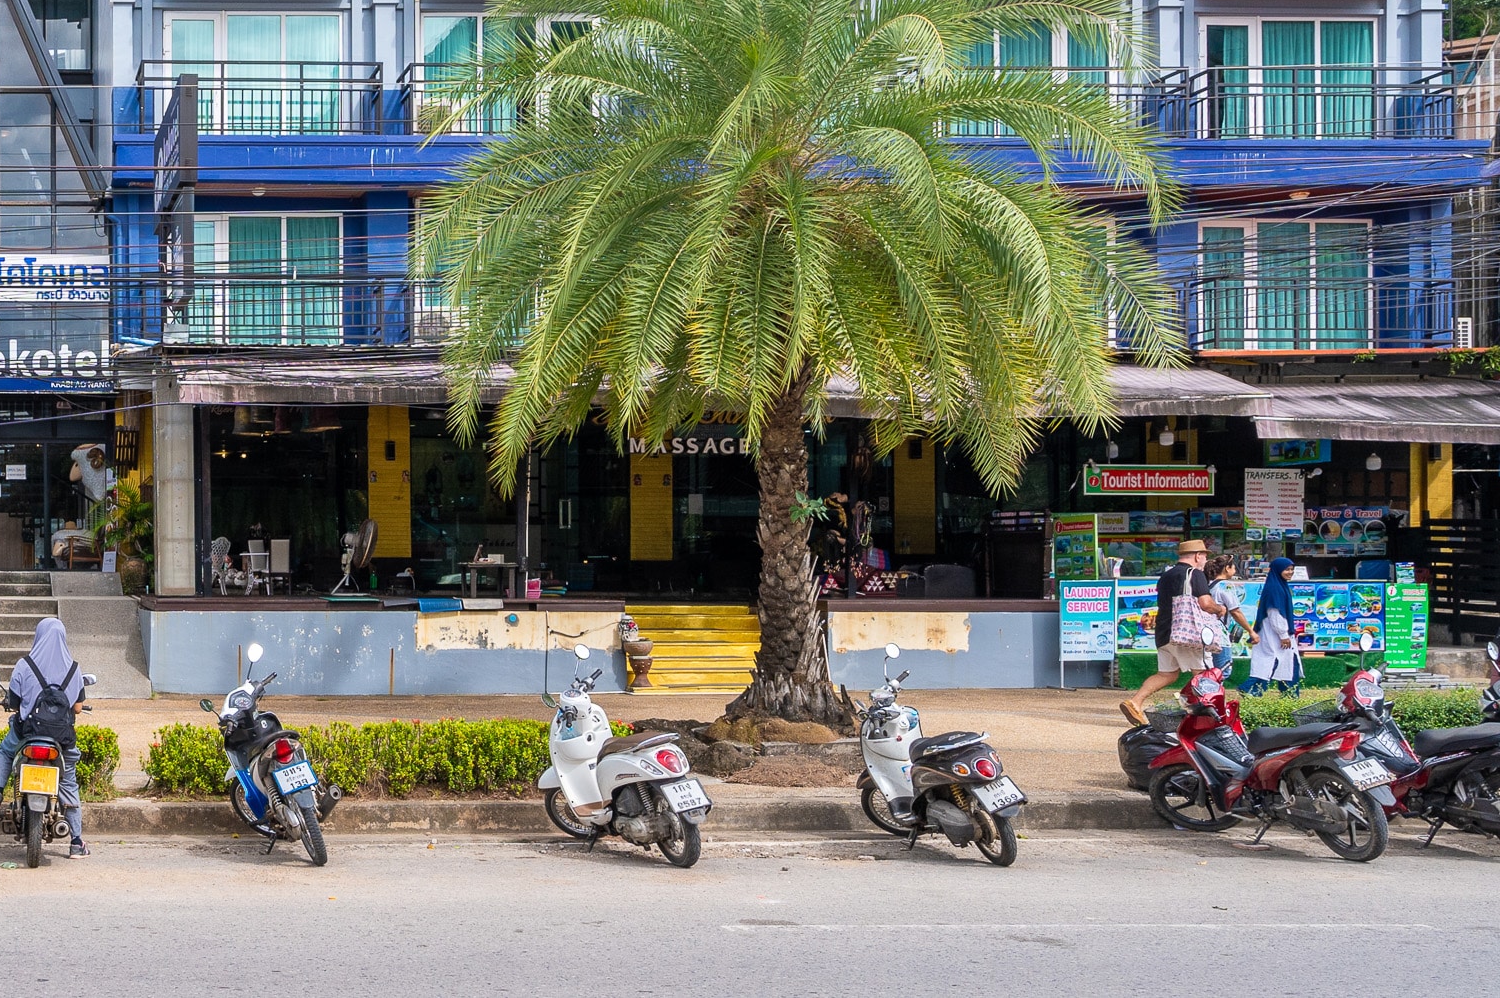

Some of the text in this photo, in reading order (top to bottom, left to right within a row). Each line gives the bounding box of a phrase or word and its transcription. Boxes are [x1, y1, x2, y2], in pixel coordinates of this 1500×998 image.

[1101, 472, 1142, 488] Tourist
[1144, 472, 1209, 488] Information
[1321, 509, 1341, 518] Tour
[1344, 509, 1352, 518] &
[1355, 509, 1383, 518] Travel
[1064, 587, 1111, 599] LAUNDRY
[1067, 601, 1109, 612] SERVICE
[991, 793, 1018, 809] 1369
